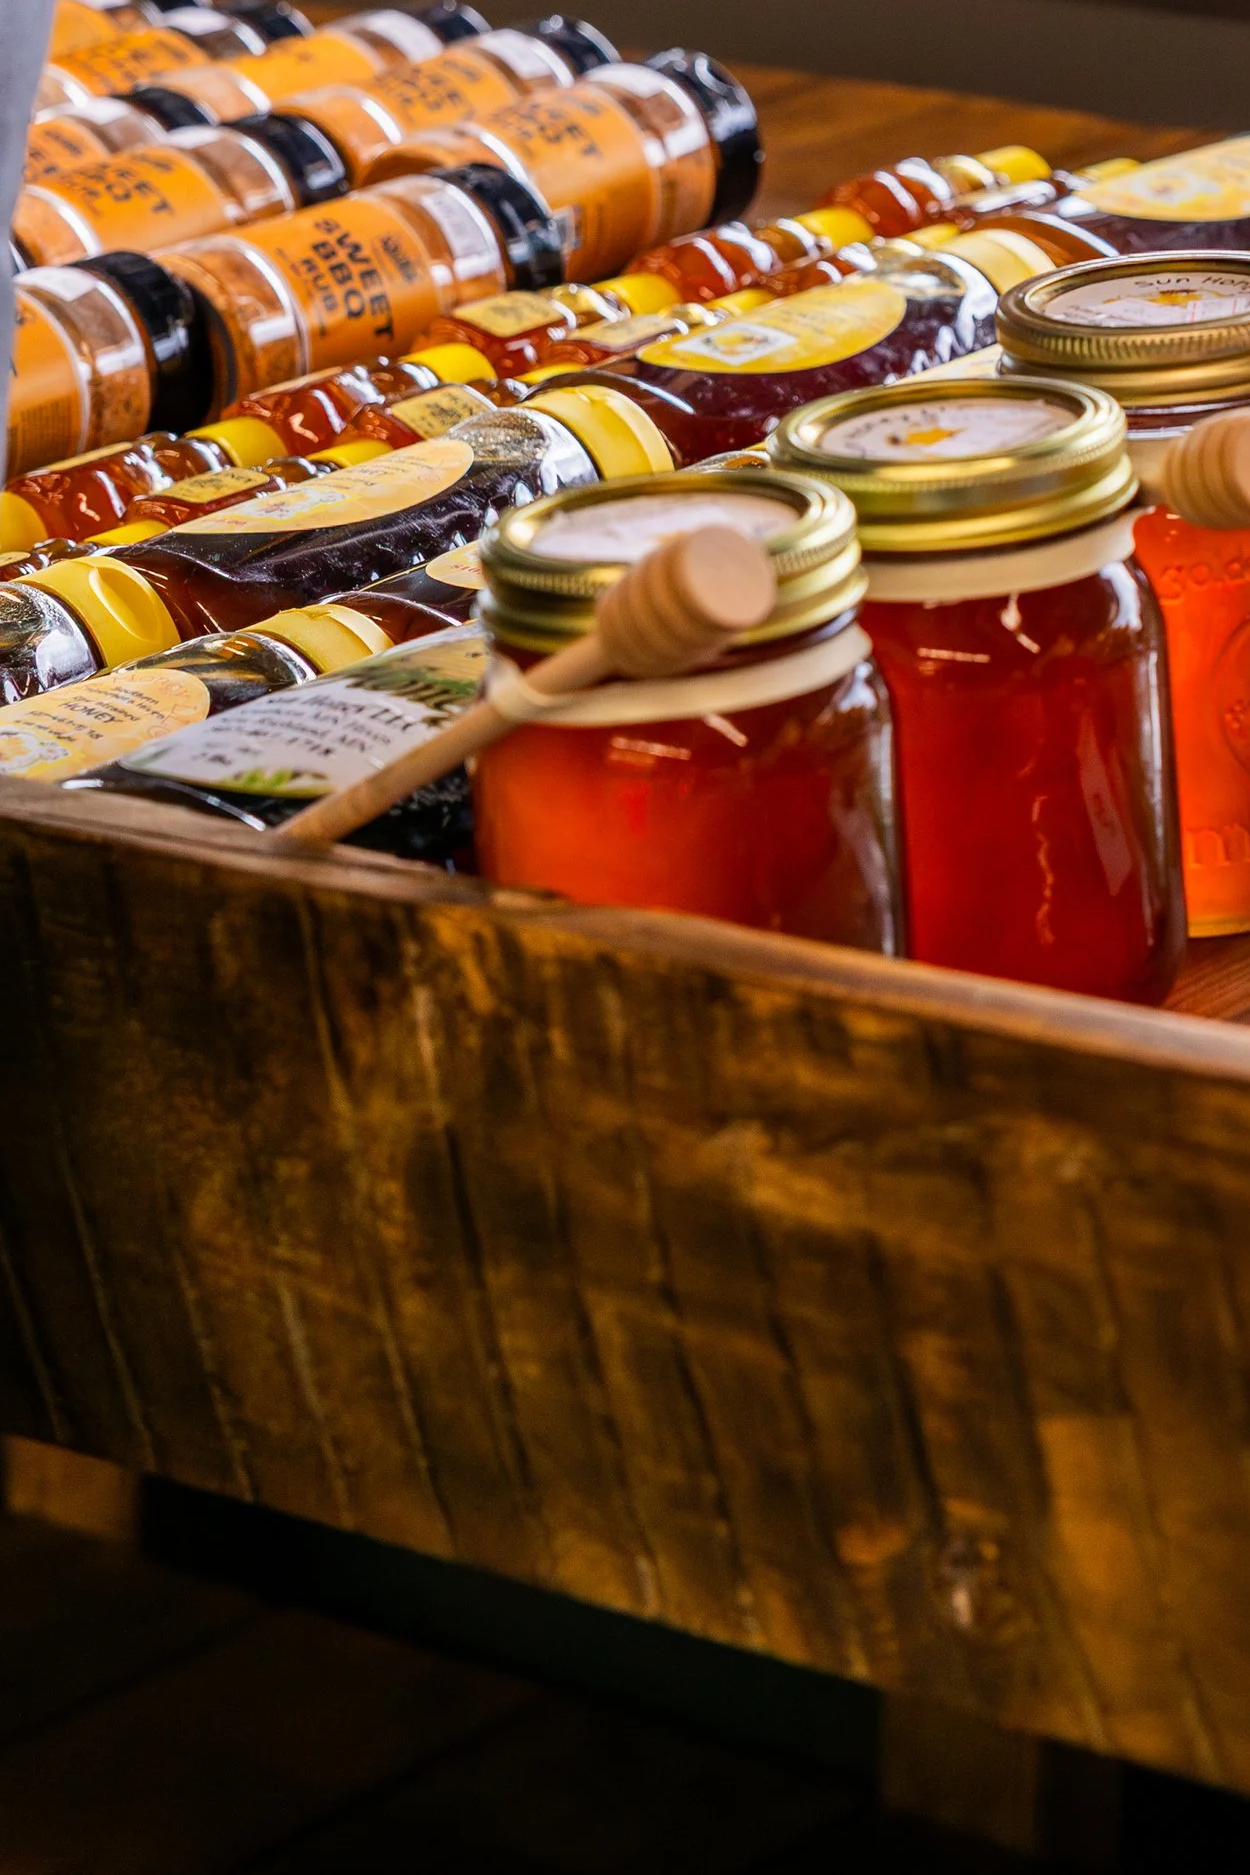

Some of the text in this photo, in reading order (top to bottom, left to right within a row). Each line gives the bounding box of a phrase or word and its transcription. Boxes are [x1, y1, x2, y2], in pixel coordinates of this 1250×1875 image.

[301, 257, 338, 312] RUB
[311, 240, 366, 319] BBQ
[314, 218, 394, 342] SWEET
[59, 700, 125, 724] HONEY
